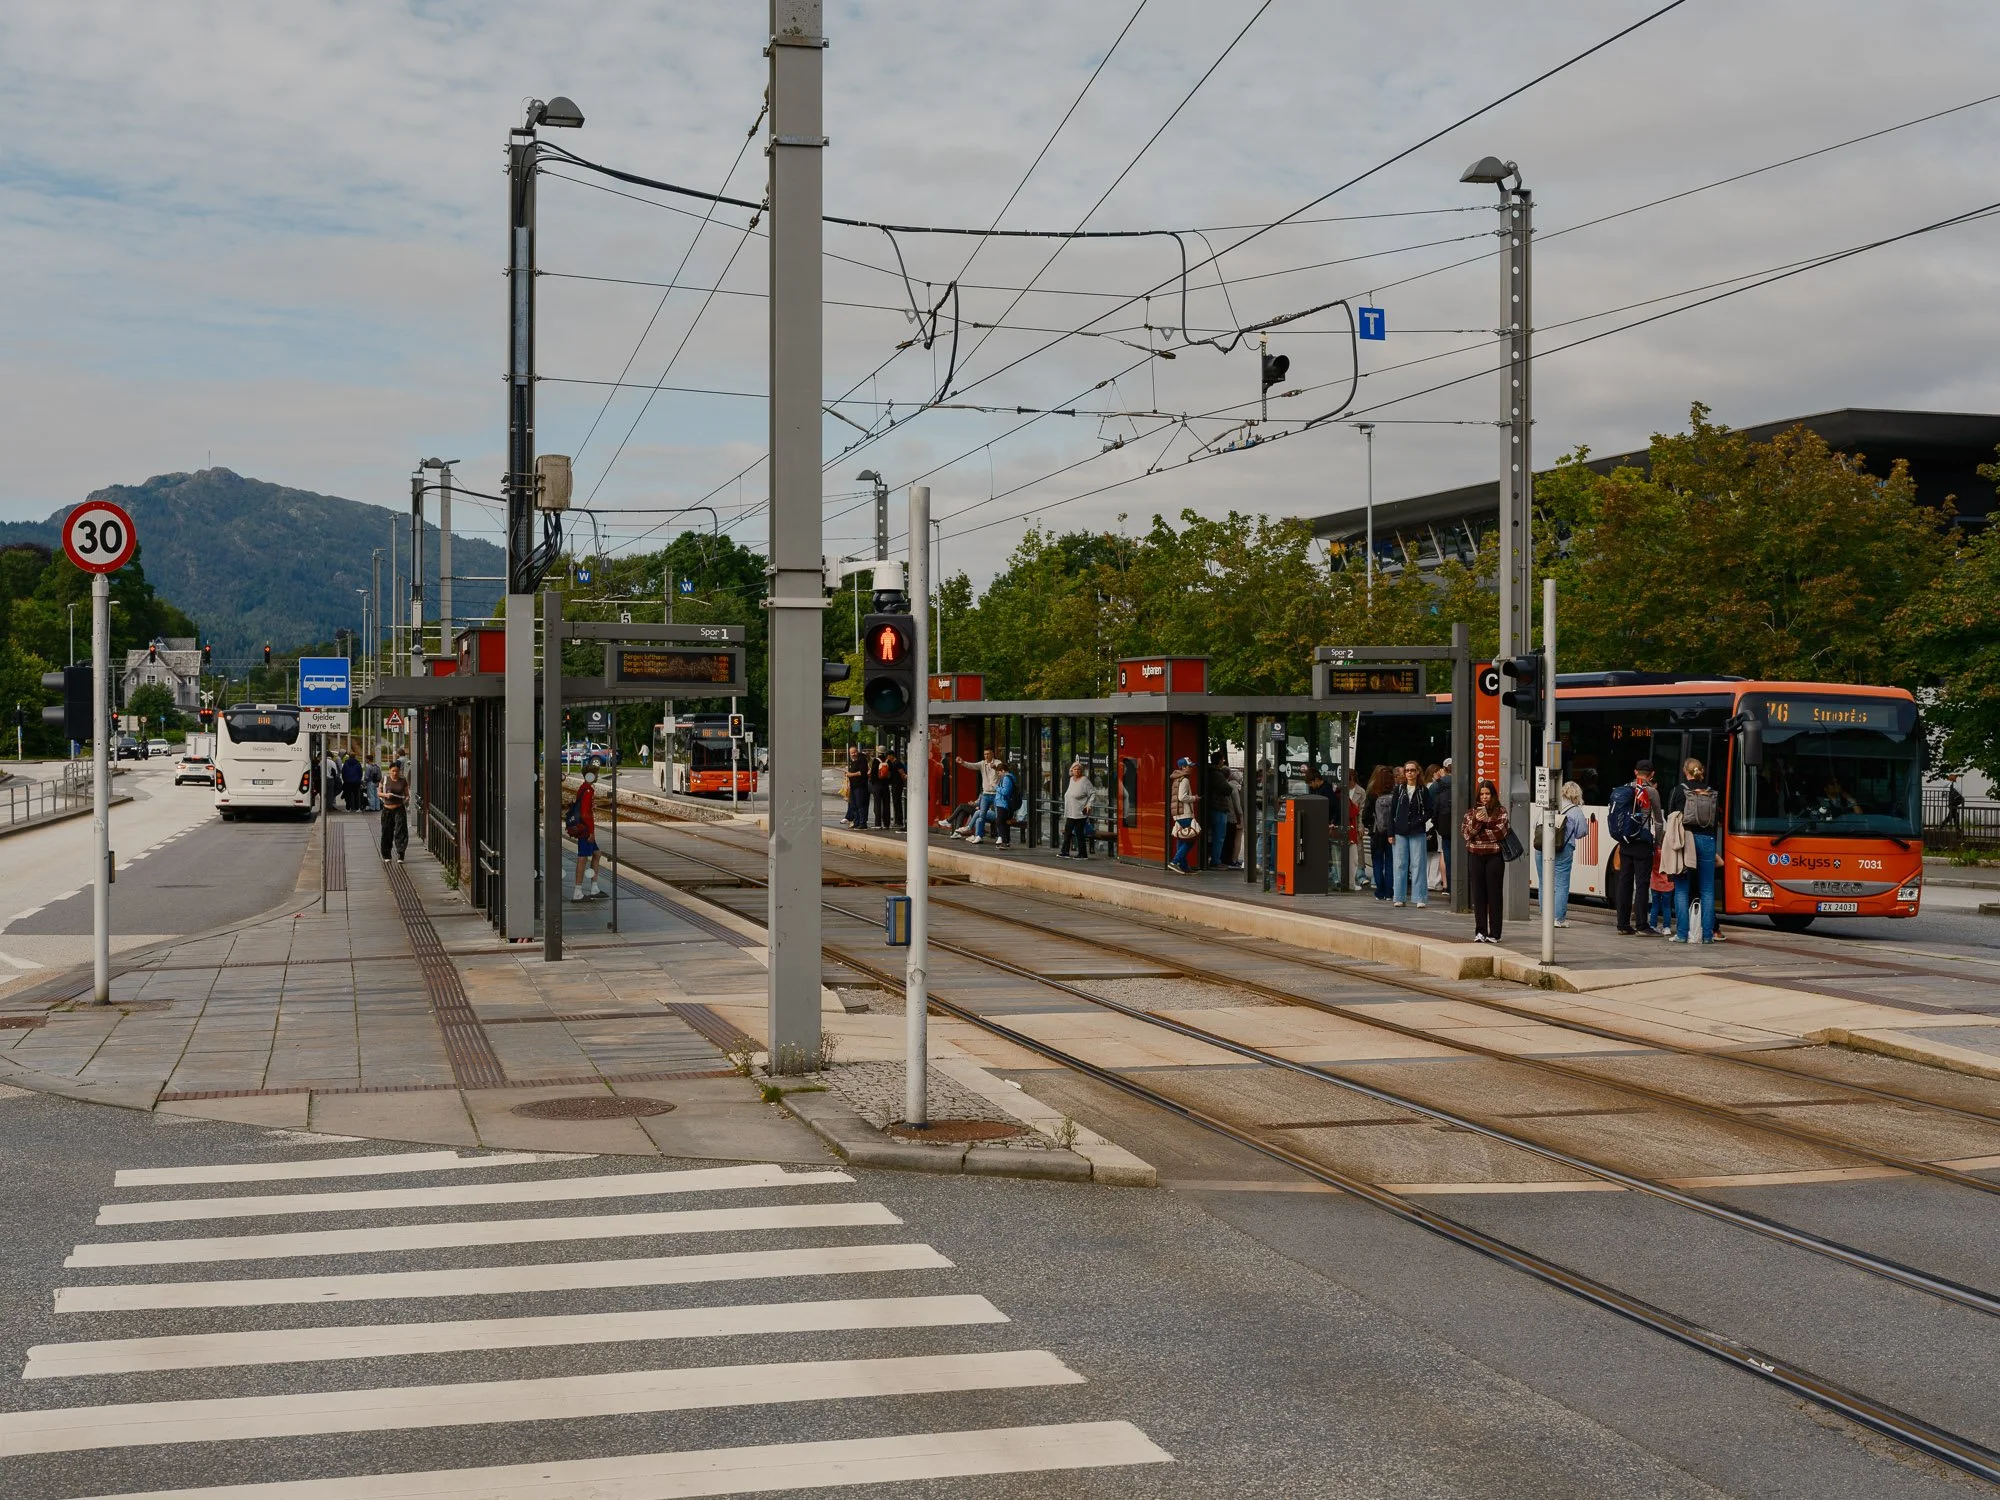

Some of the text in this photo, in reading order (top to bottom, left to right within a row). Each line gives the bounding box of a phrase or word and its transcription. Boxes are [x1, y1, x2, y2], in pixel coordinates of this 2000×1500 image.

[1364, 312, 1379, 335] T
[78, 520, 122, 554] 30
[578, 572, 590, 581] W
[681, 582, 693, 592] W
[623, 614, 630, 624] 5
[700, 627, 729, 640] Spor 1
[623, 653, 641, 661] Bergen
[1331, 648, 1354, 659] Spor 2
[1141, 664, 1162, 678] bybanen
[1485, 673, 1499, 691] C
[312, 713, 336, 722] Gjelder
[1766, 702, 1789, 722] 76
[307, 722, 341, 730] høyre felt
[1791, 855, 1831, 870] skyss
[1858, 859, 1883, 870] 7031
[1813, 881, 1863, 894] IVECO
[1823, 903, 1856, 911] ZX 24031
